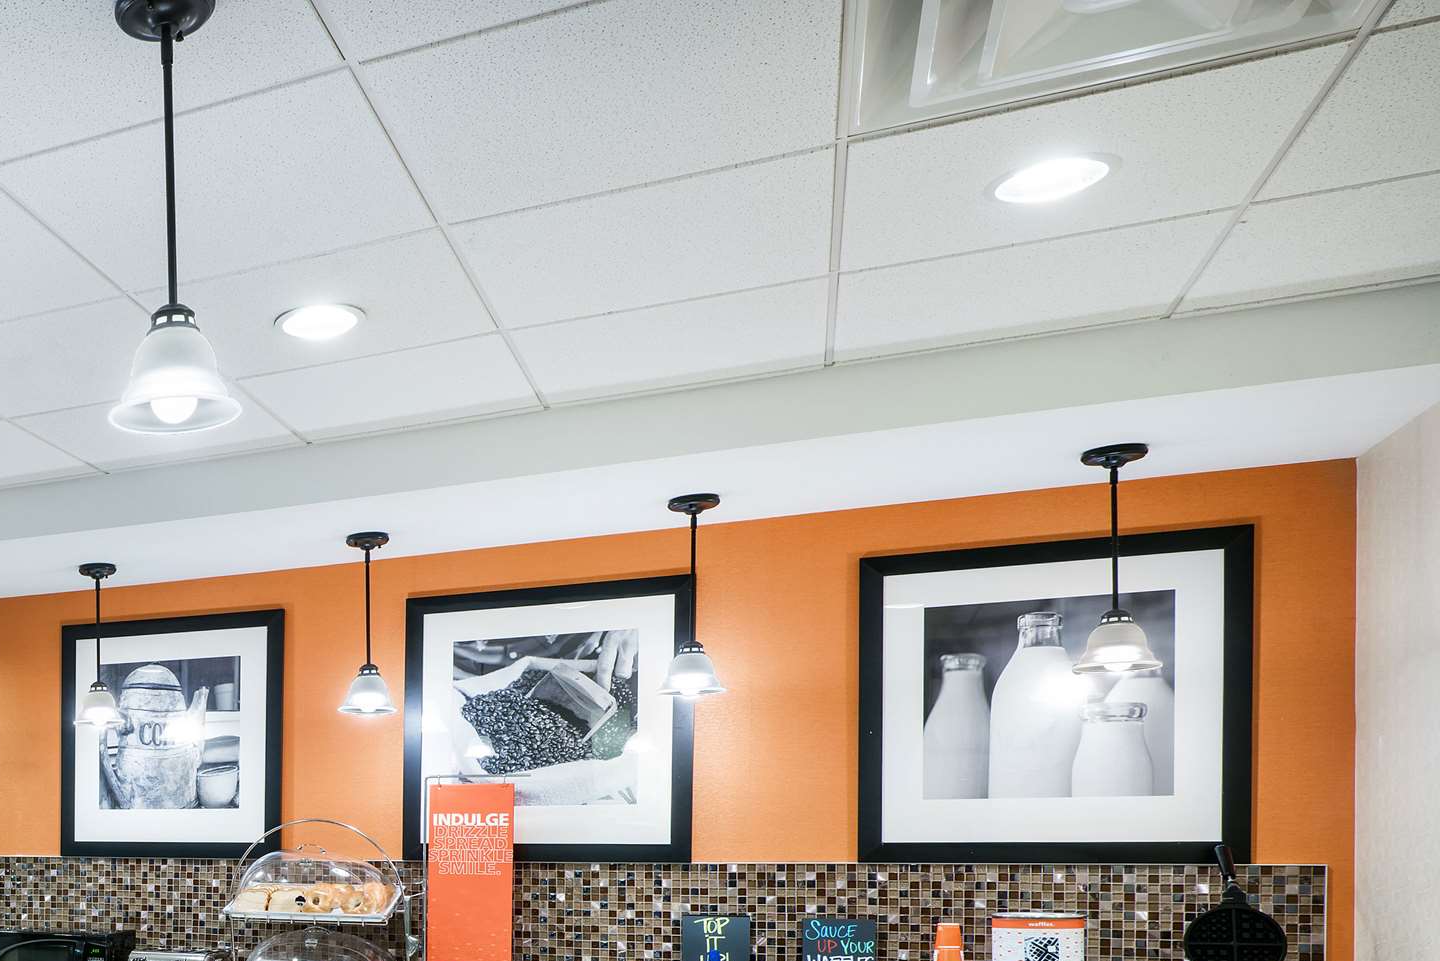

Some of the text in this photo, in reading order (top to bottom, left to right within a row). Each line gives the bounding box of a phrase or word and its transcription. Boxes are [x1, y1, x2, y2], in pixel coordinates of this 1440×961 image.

[432, 813, 509, 826] INDULGE
[433, 825, 509, 838] DRIZZLE
[433, 836, 509, 850] SPREAD
[428, 848, 514, 863] SPRINKLE
[438, 861, 501, 875] SMILE.
[694, 917, 729, 934] TOP
[817, 938, 875, 955] UP YOUR
